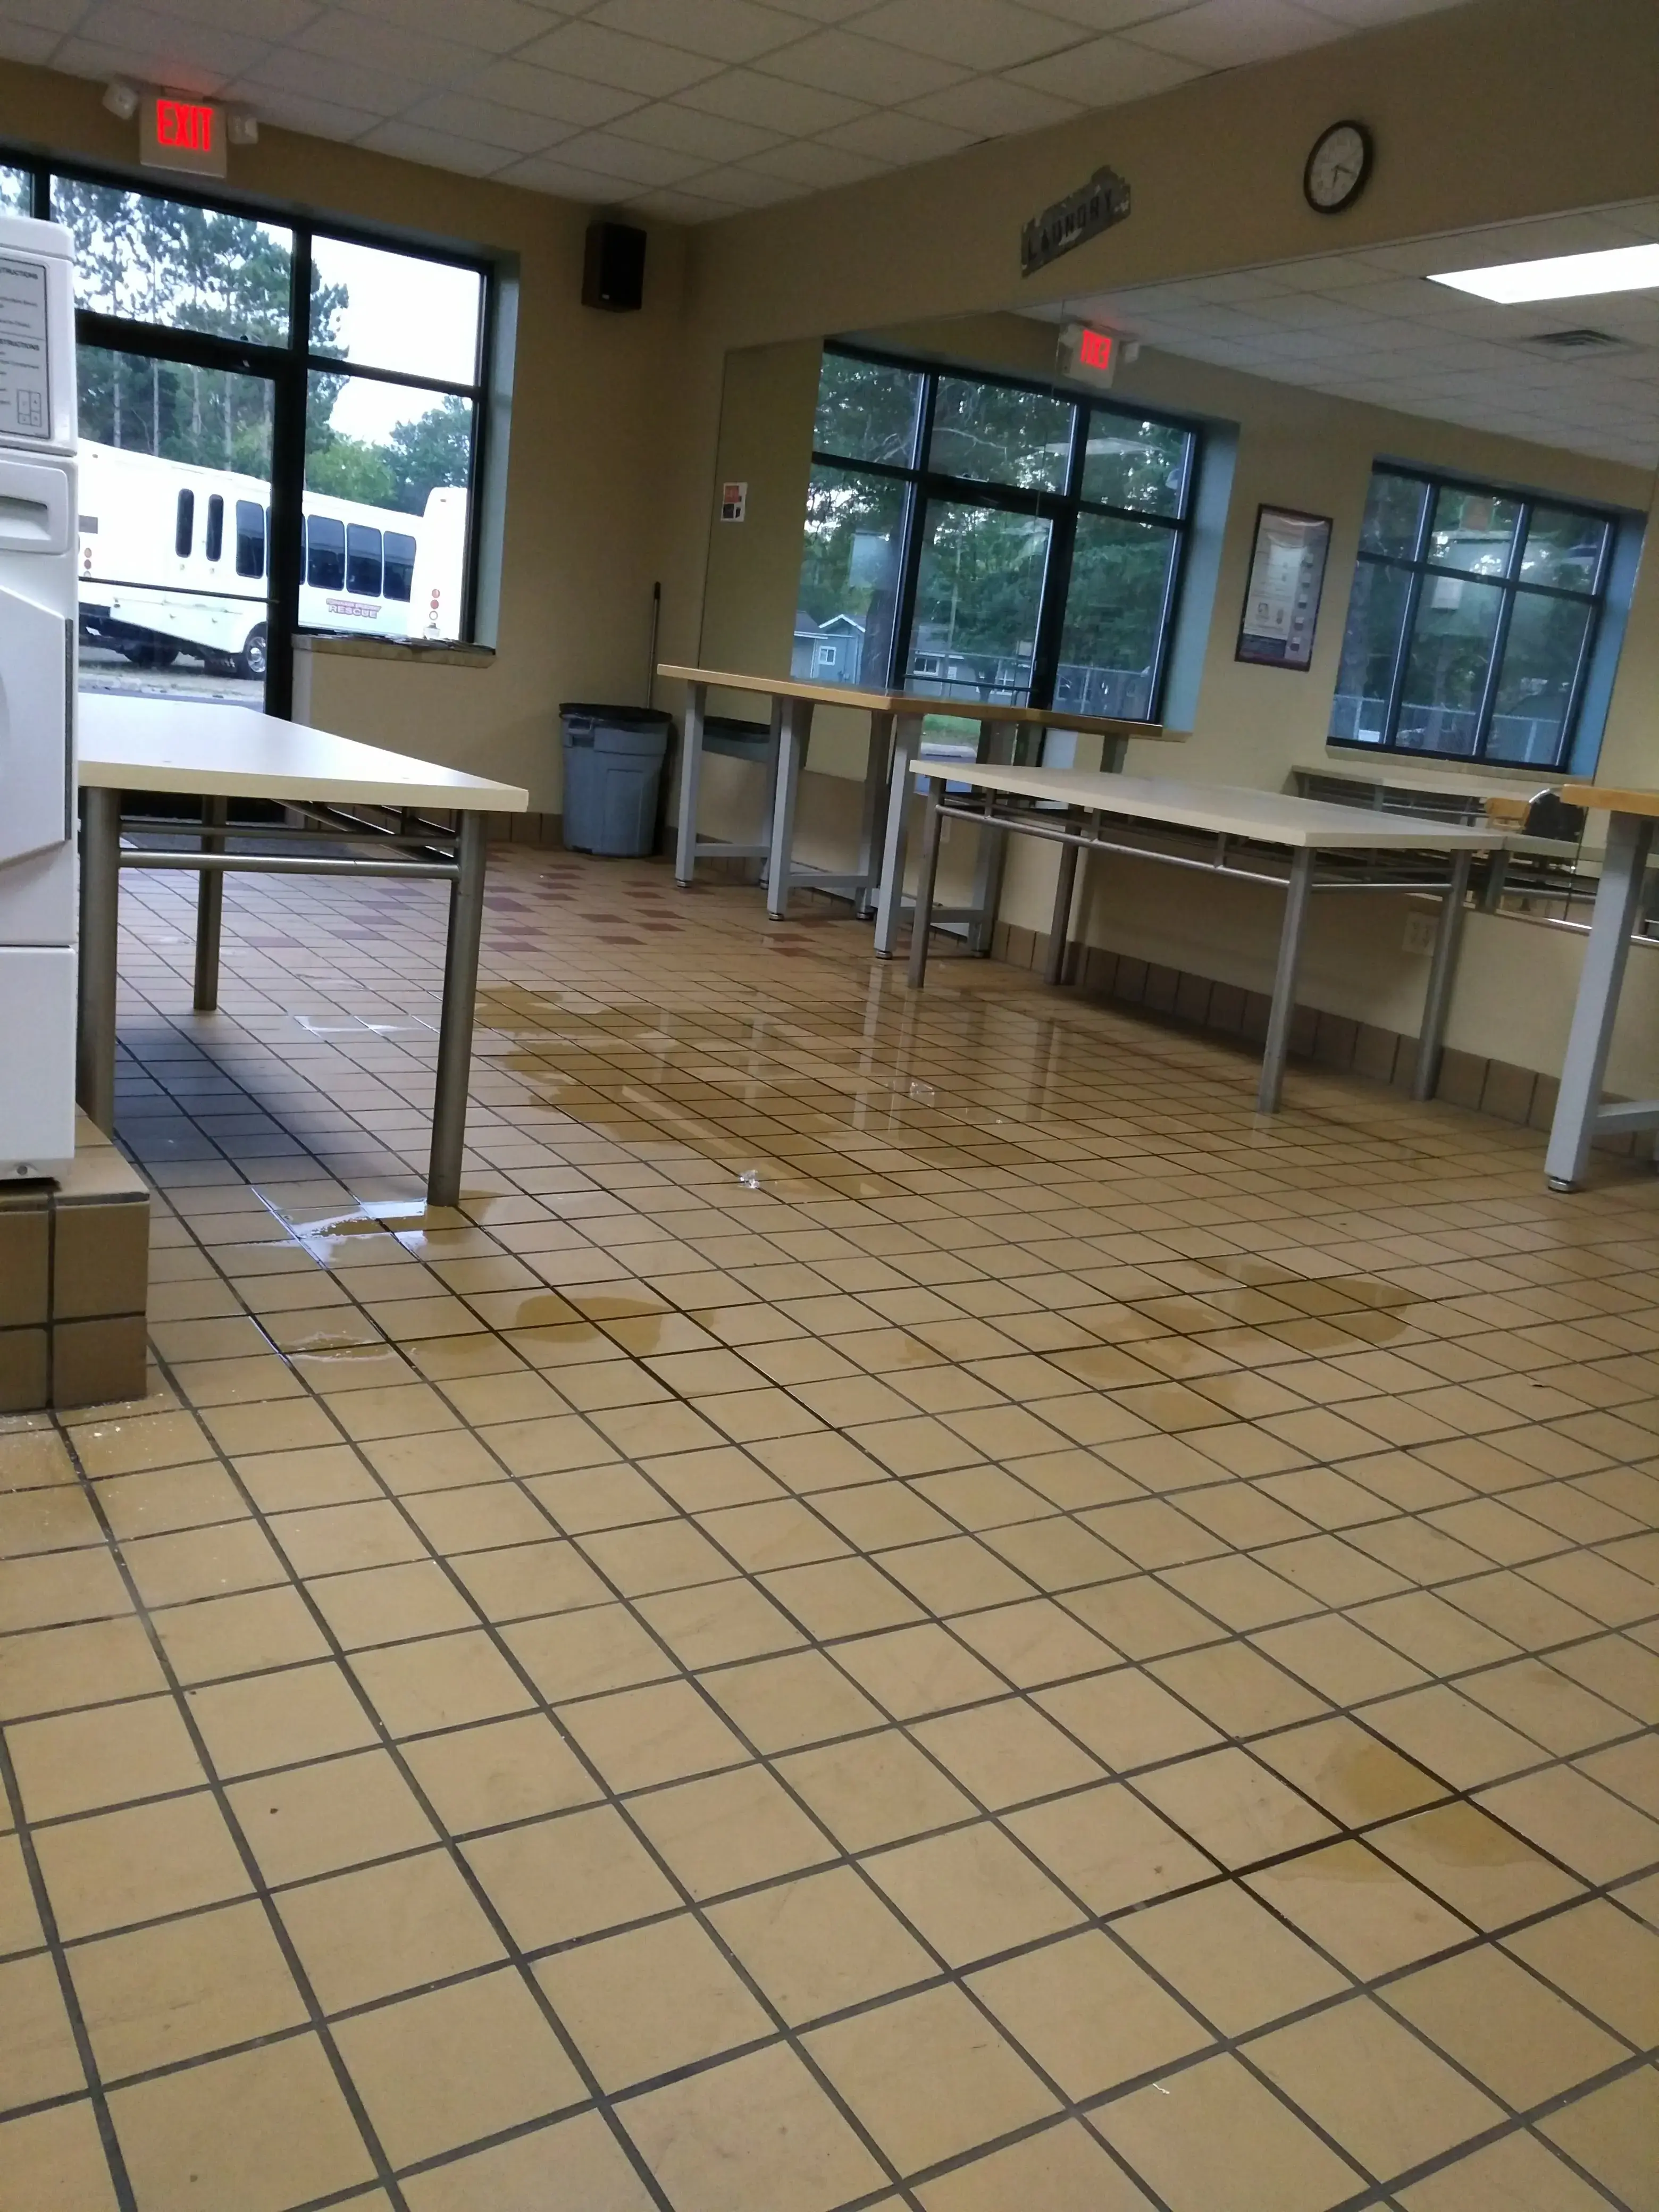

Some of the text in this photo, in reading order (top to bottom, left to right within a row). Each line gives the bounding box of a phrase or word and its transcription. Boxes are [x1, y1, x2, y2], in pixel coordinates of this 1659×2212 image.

[157, 99, 213, 152] EXIT
[1028, 188, 1112, 261] LAUNDRY
[328, 604, 378, 619] RESCUE
